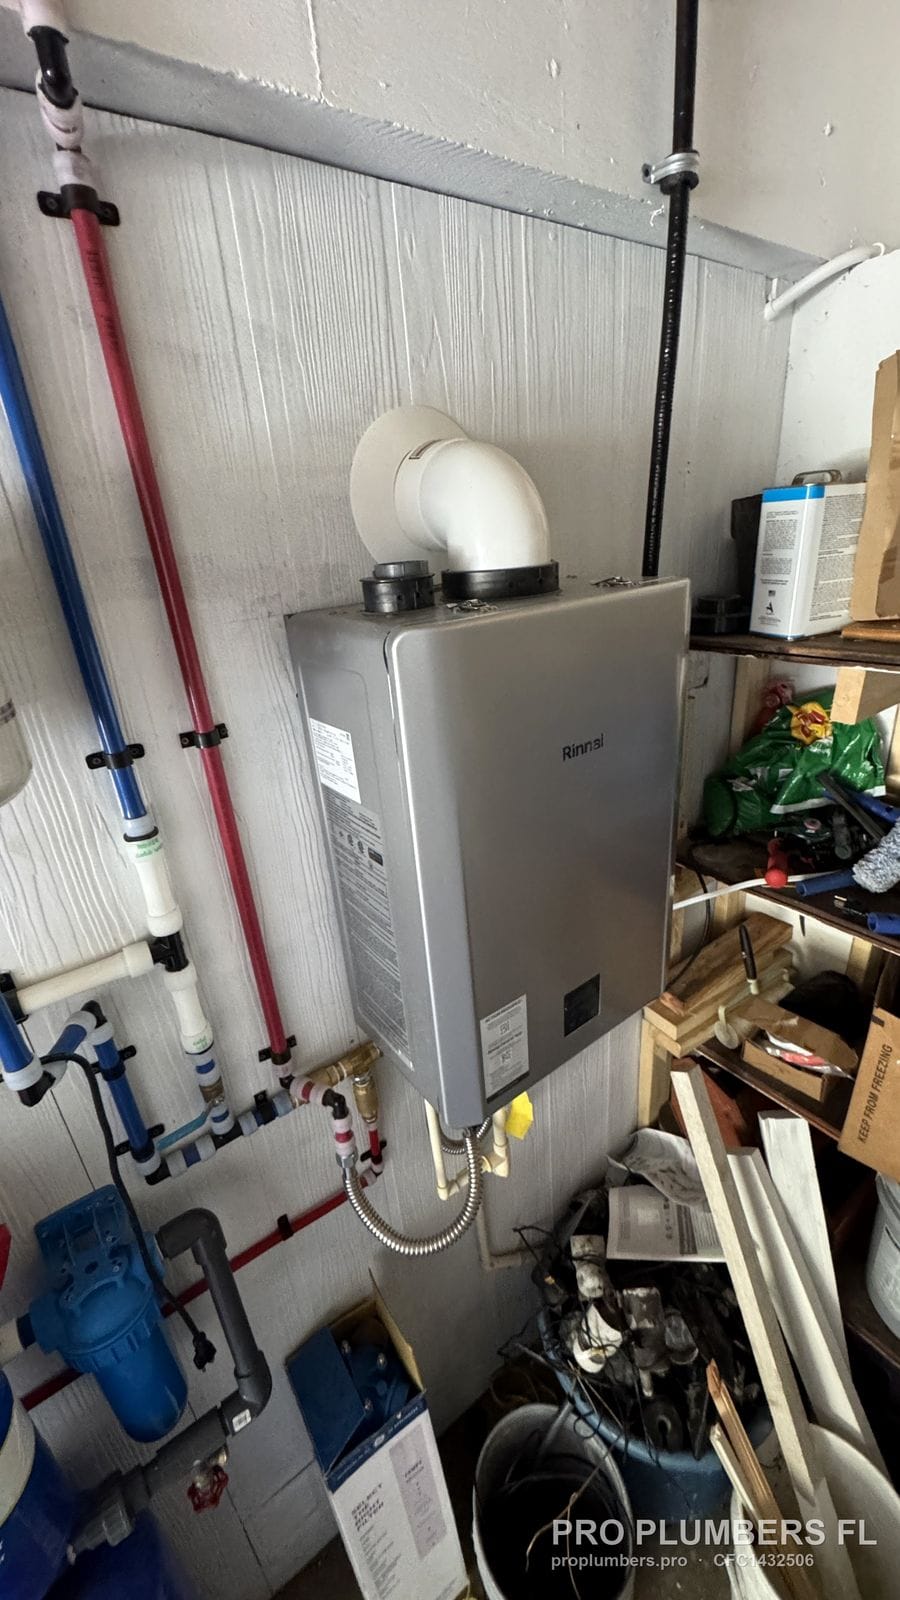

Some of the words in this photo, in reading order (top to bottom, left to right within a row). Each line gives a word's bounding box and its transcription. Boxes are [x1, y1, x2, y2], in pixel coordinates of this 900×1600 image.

[562, 732, 604, 761] Rinnai
[871, 1043, 893, 1093] FREEZING
[863, 1091, 879, 1120] FROM
[857, 1118, 870, 1144] KEEP
